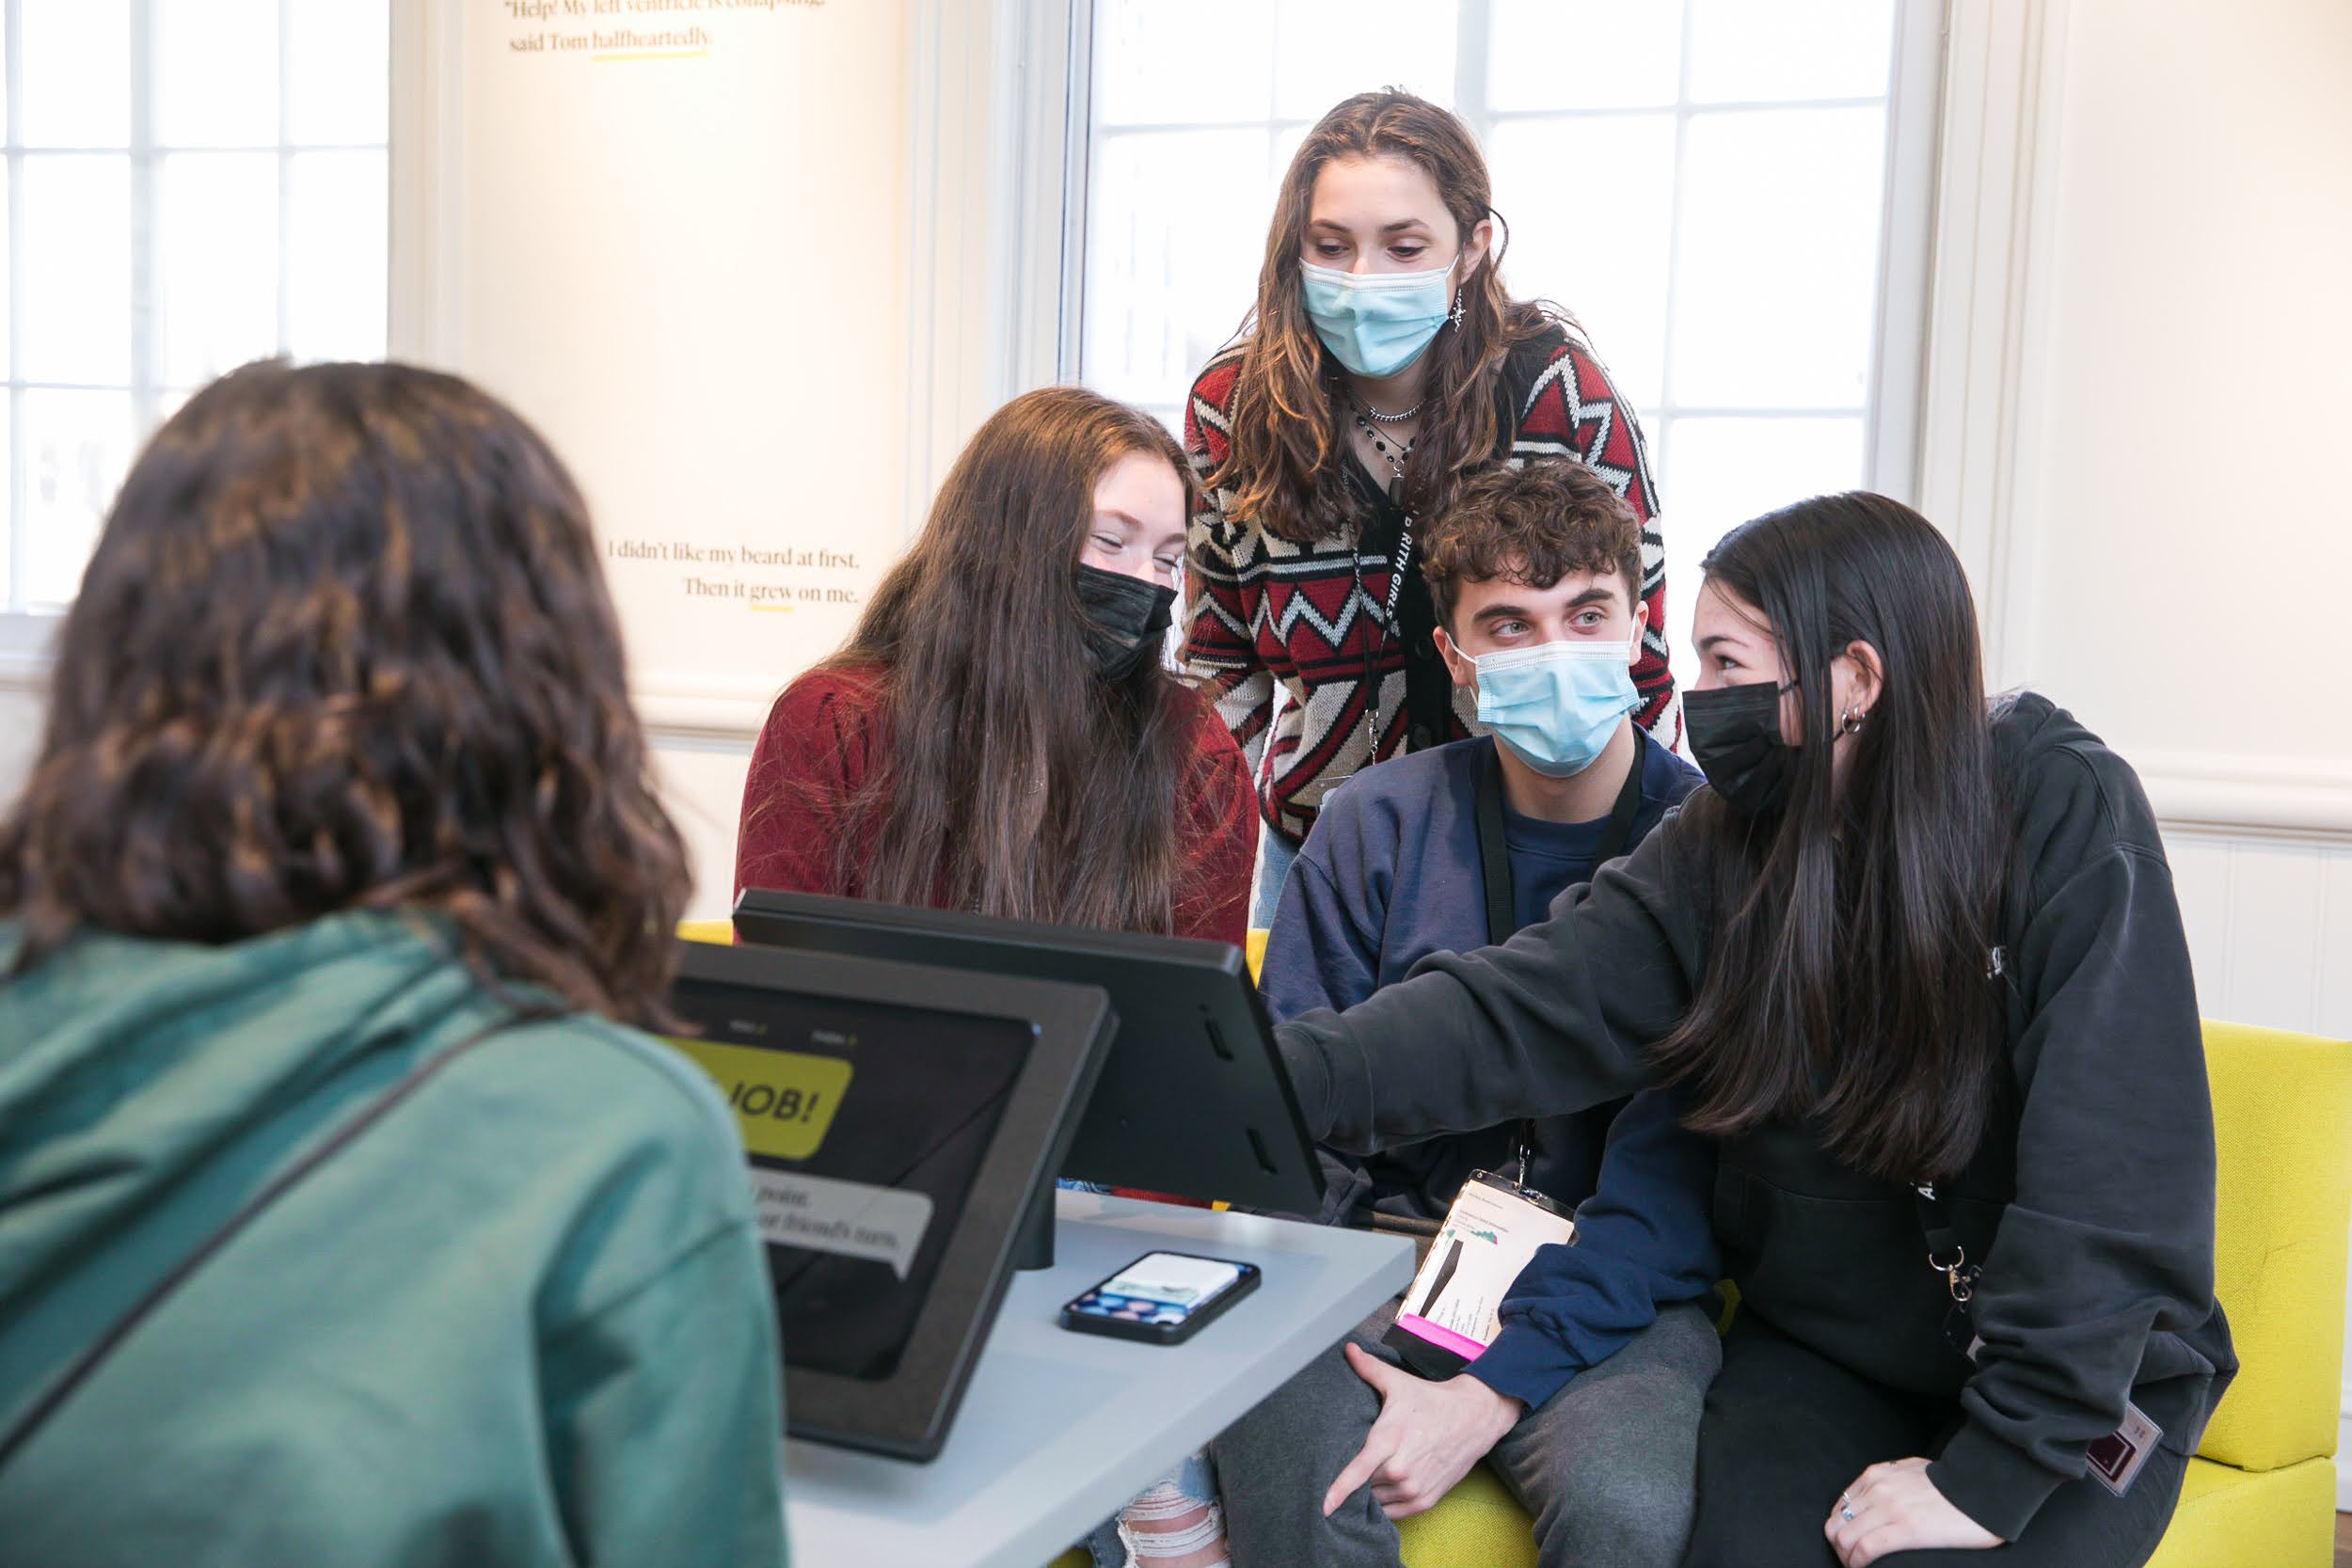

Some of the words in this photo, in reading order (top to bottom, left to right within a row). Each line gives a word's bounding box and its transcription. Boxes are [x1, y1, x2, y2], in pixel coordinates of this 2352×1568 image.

[564, 0, 587, 18] My
[509, 32, 545, 52] said
[548, 33, 588, 51] Tom
[609, 541, 613, 557] I
[617, 541, 668, 559] didn't
[674, 542, 704, 562] like
[709, 547, 734, 566] my
[740, 545, 792, 566] beard
[797, 550, 813, 565] at
[818, 546, 860, 569] first.
[683, 577, 728, 597] Then
[733, 579, 746, 596] it
[750, 585, 795, 601] grew
[798, 587, 821, 602] on
[826, 588, 859, 604] me.
[1386, 574, 1402, 620] GIRLS
